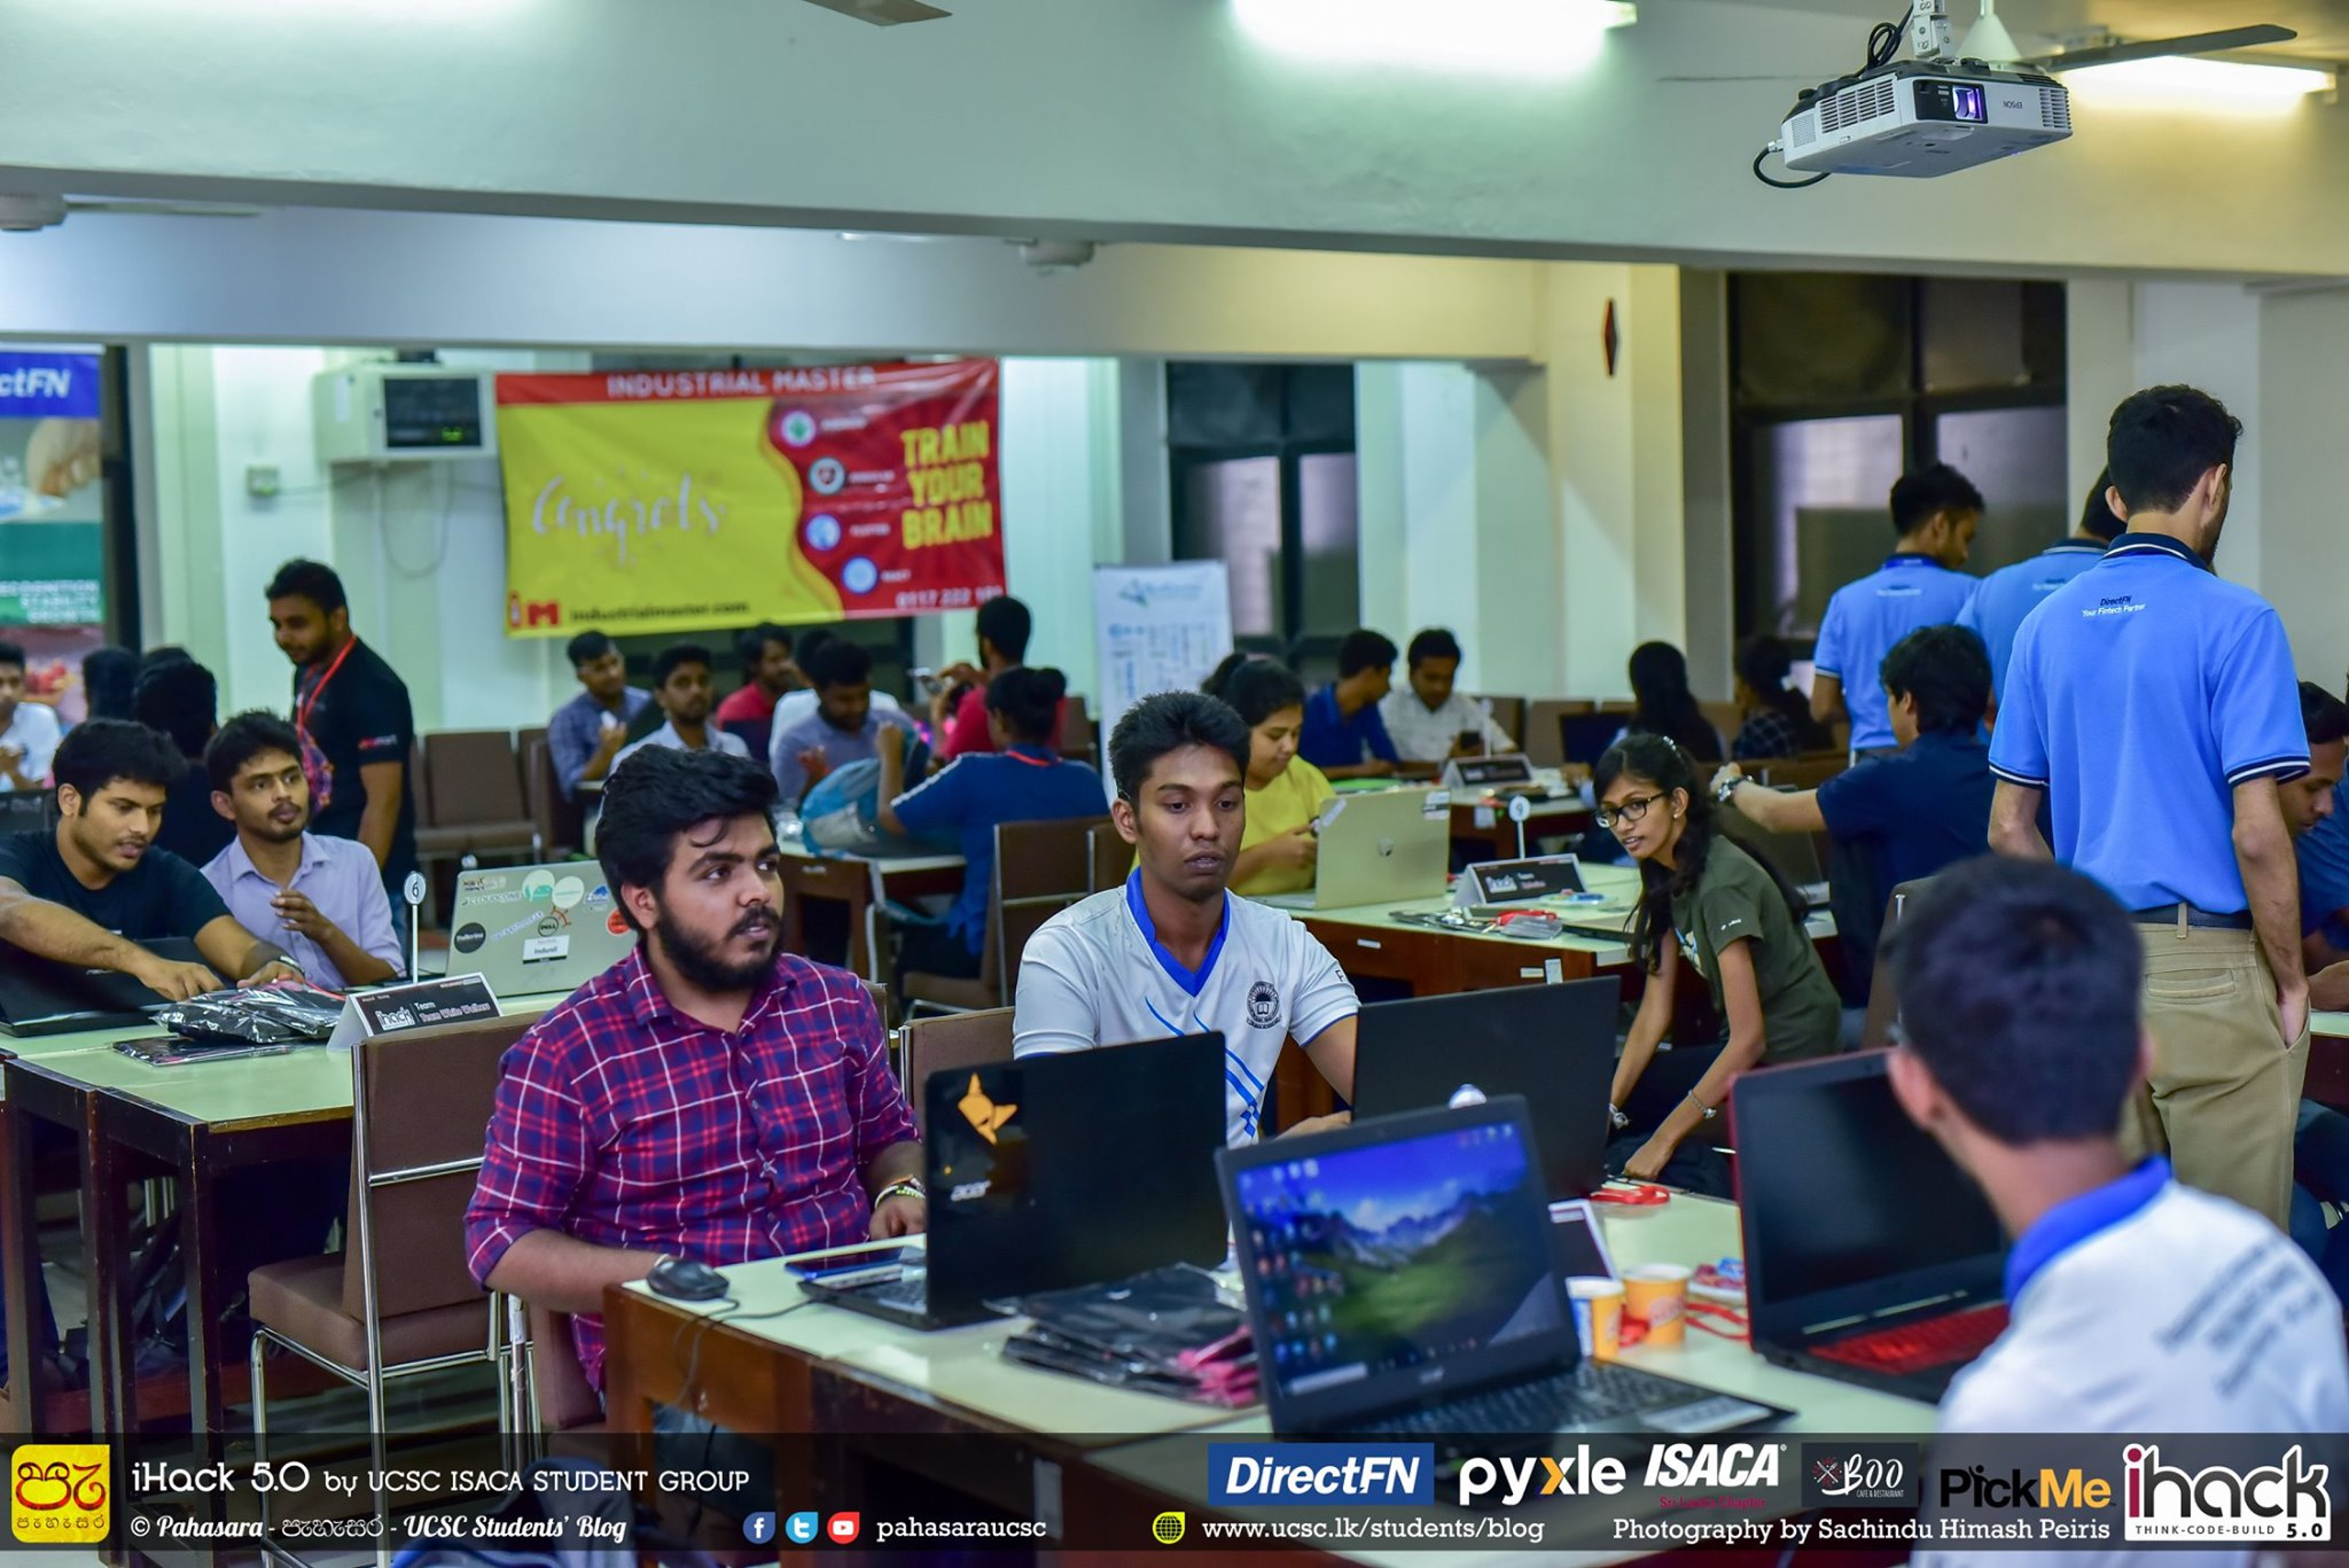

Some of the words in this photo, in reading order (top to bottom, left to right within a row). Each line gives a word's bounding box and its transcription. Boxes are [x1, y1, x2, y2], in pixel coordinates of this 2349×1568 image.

[2003, 100, 2023, 110] EPSON
[606, 371, 767, 399] INDUSTRIAL
[772, 366, 876, 393] MASTER
[900, 419, 990, 467] TRAIN
[907, 461, 984, 508] YOUR
[901, 500, 993, 550] BRAIN
[2082, 609, 2097, 617] Your
[2097, 606, 2122, 615] Fintech
[2099, 595, 2132, 607] DirectFN
[412, 881, 419, 898] 6
